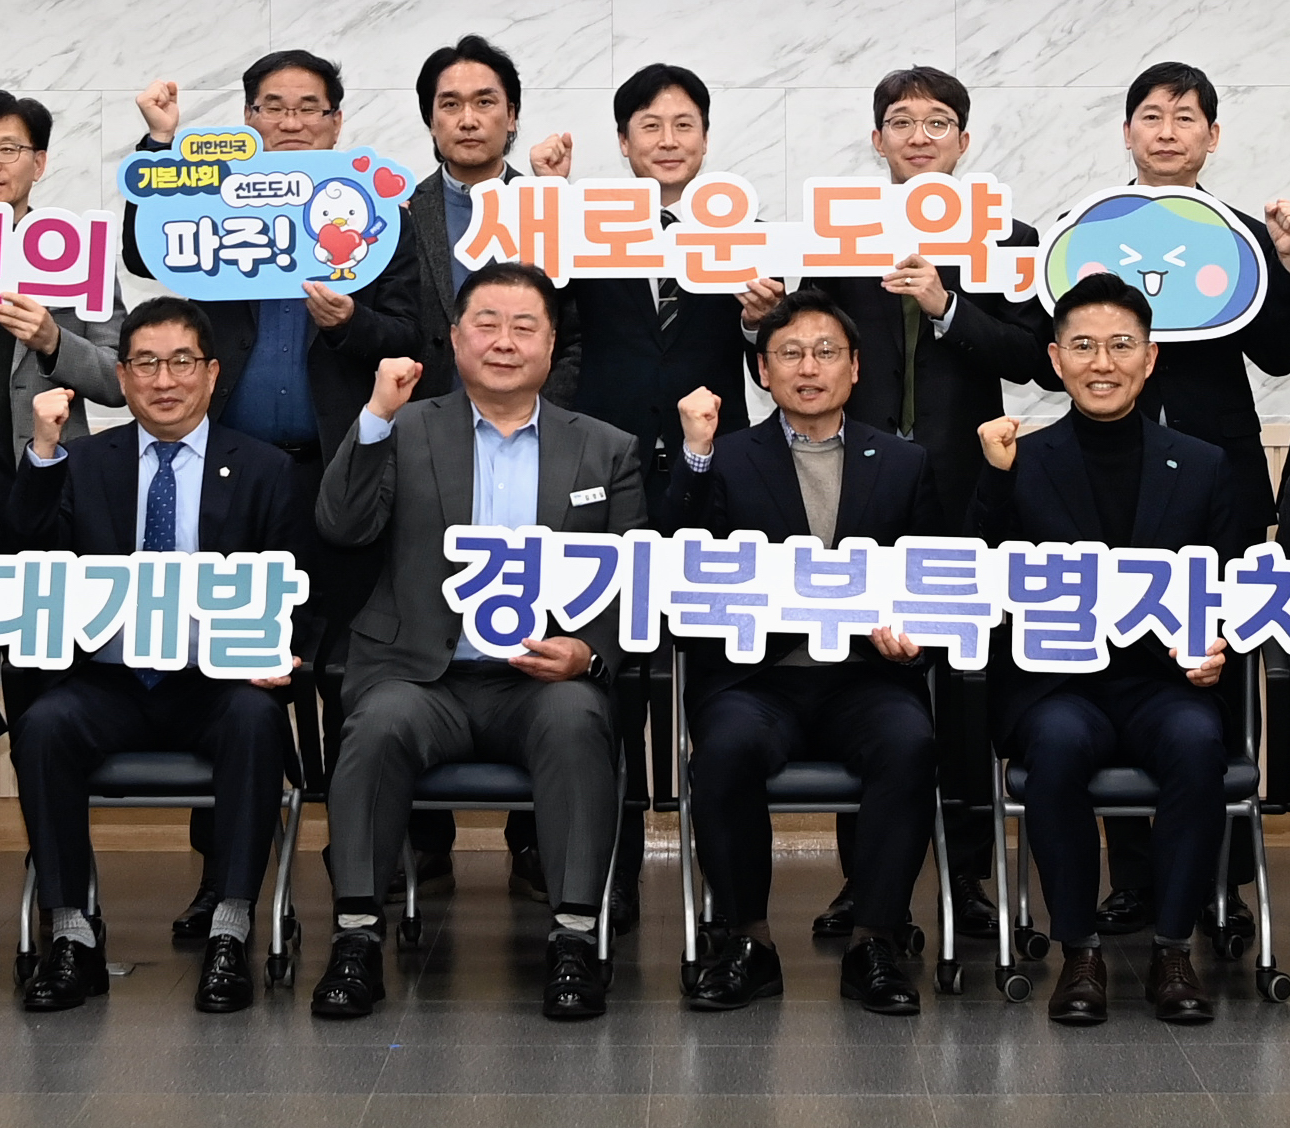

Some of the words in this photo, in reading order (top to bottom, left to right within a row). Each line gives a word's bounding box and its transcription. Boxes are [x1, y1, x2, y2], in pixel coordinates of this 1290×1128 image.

[189, 138, 247, 155] 대한민국
[137, 164, 220, 189] 기본사회
[233, 178, 301, 200] 선도도시
[163, 215, 296, 275] 파주!
[464, 181, 767, 284] 새로운
[802, 182, 1036, 293] 도약,
